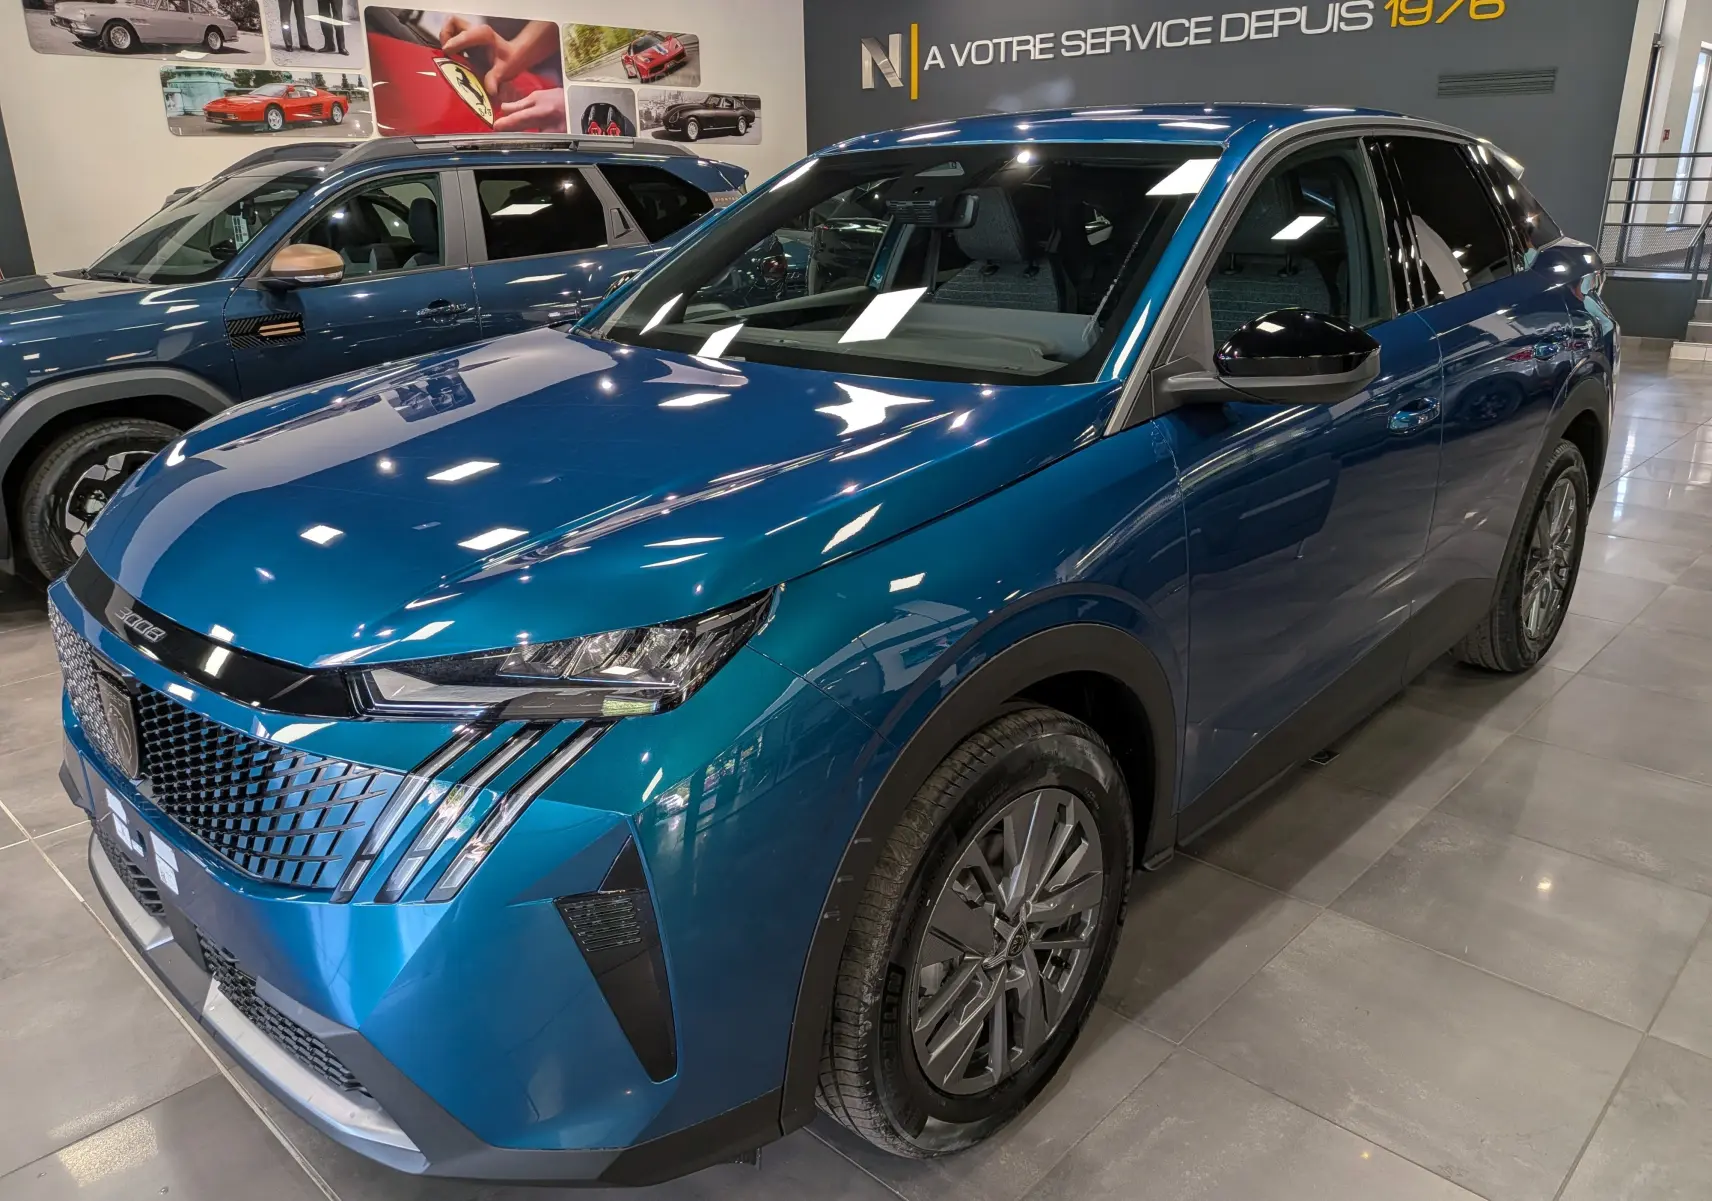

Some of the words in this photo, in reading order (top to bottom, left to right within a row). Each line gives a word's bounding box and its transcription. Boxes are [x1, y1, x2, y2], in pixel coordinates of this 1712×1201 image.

[861, 33, 904, 90] N
[923, 45, 946, 71] A
[949, 32, 1056, 67] VOTRE
[1060, 15, 1214, 57] SERVICE
[1219, 0, 1375, 43] DEPUIS
[114, 605, 168, 643] 3008
